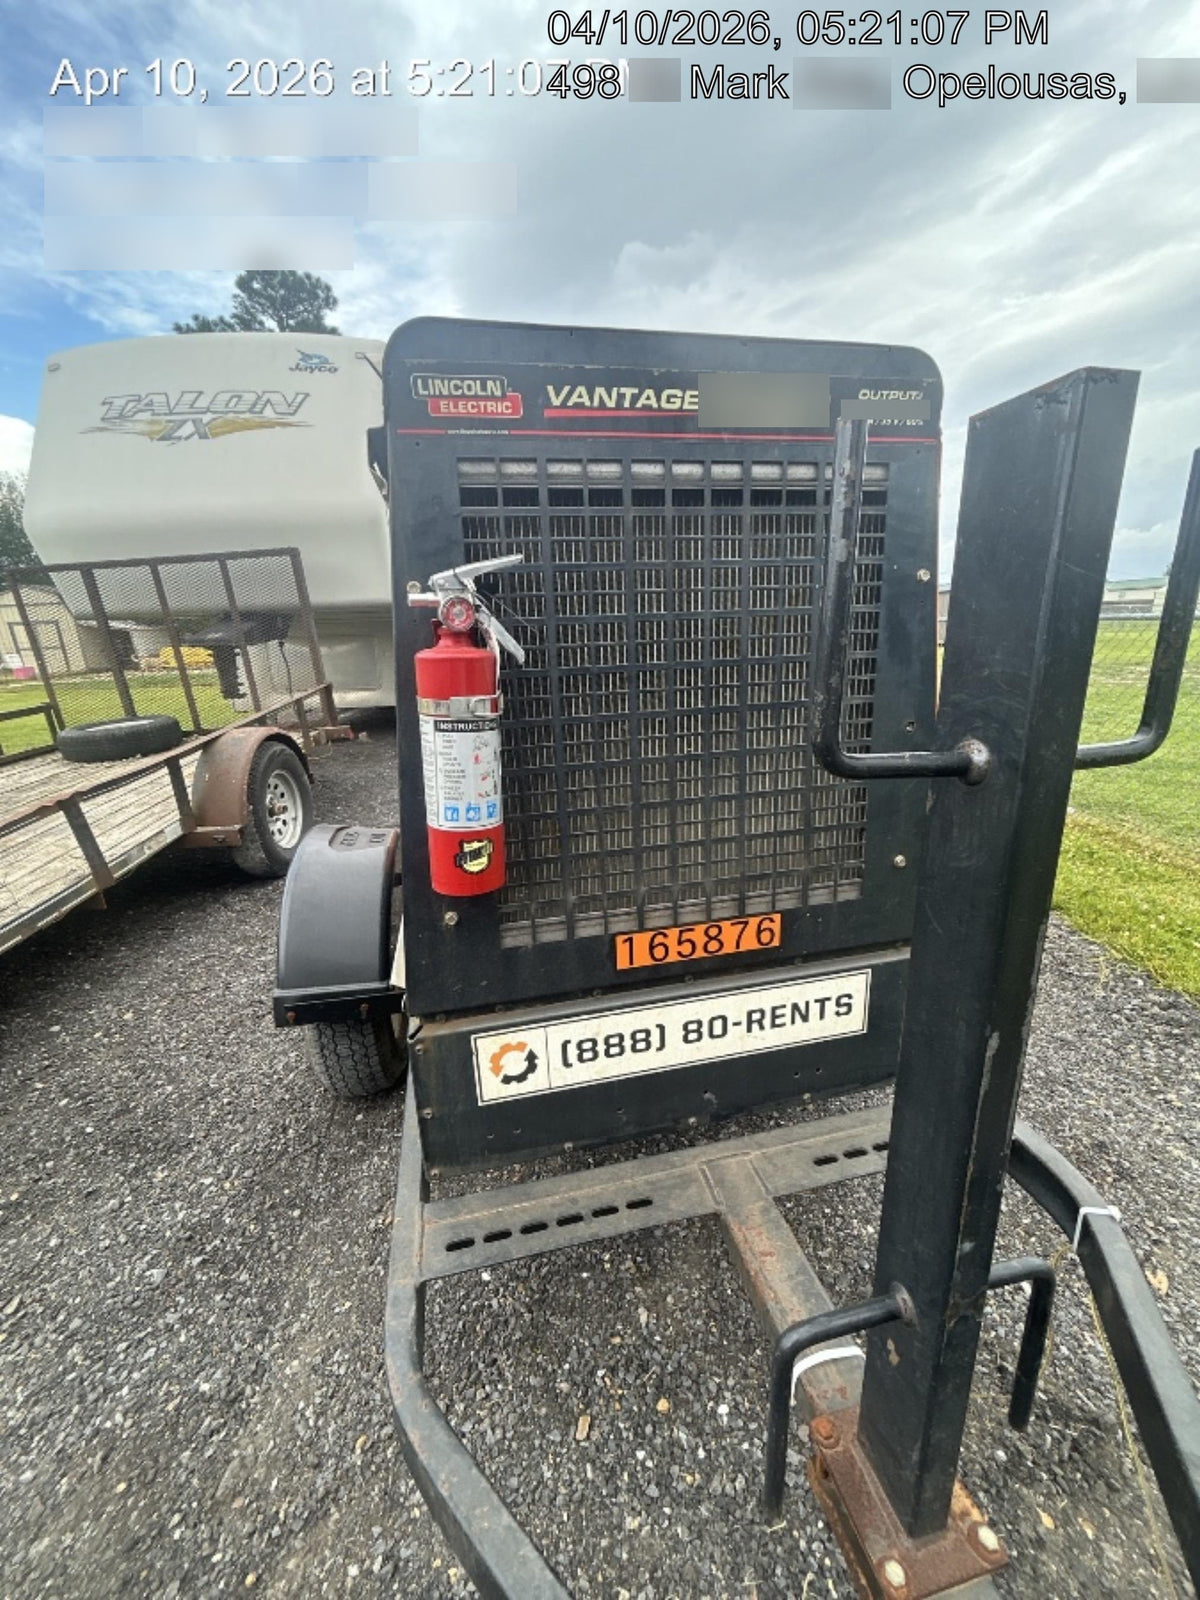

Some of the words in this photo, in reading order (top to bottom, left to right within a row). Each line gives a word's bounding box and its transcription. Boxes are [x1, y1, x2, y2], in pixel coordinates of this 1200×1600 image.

[289, 363, 338, 374] Jayco
[417, 378, 501, 396] LINCOLN
[547, 385, 698, 410] VANTAGE
[100, 391, 309, 420] TALON
[439, 400, 513, 414] ELECTRIC
[621, 917, 776, 966] 165876
[561, 1023, 664, 1068] (888)
[682, 993, 853, 1045] 80-RENTS
